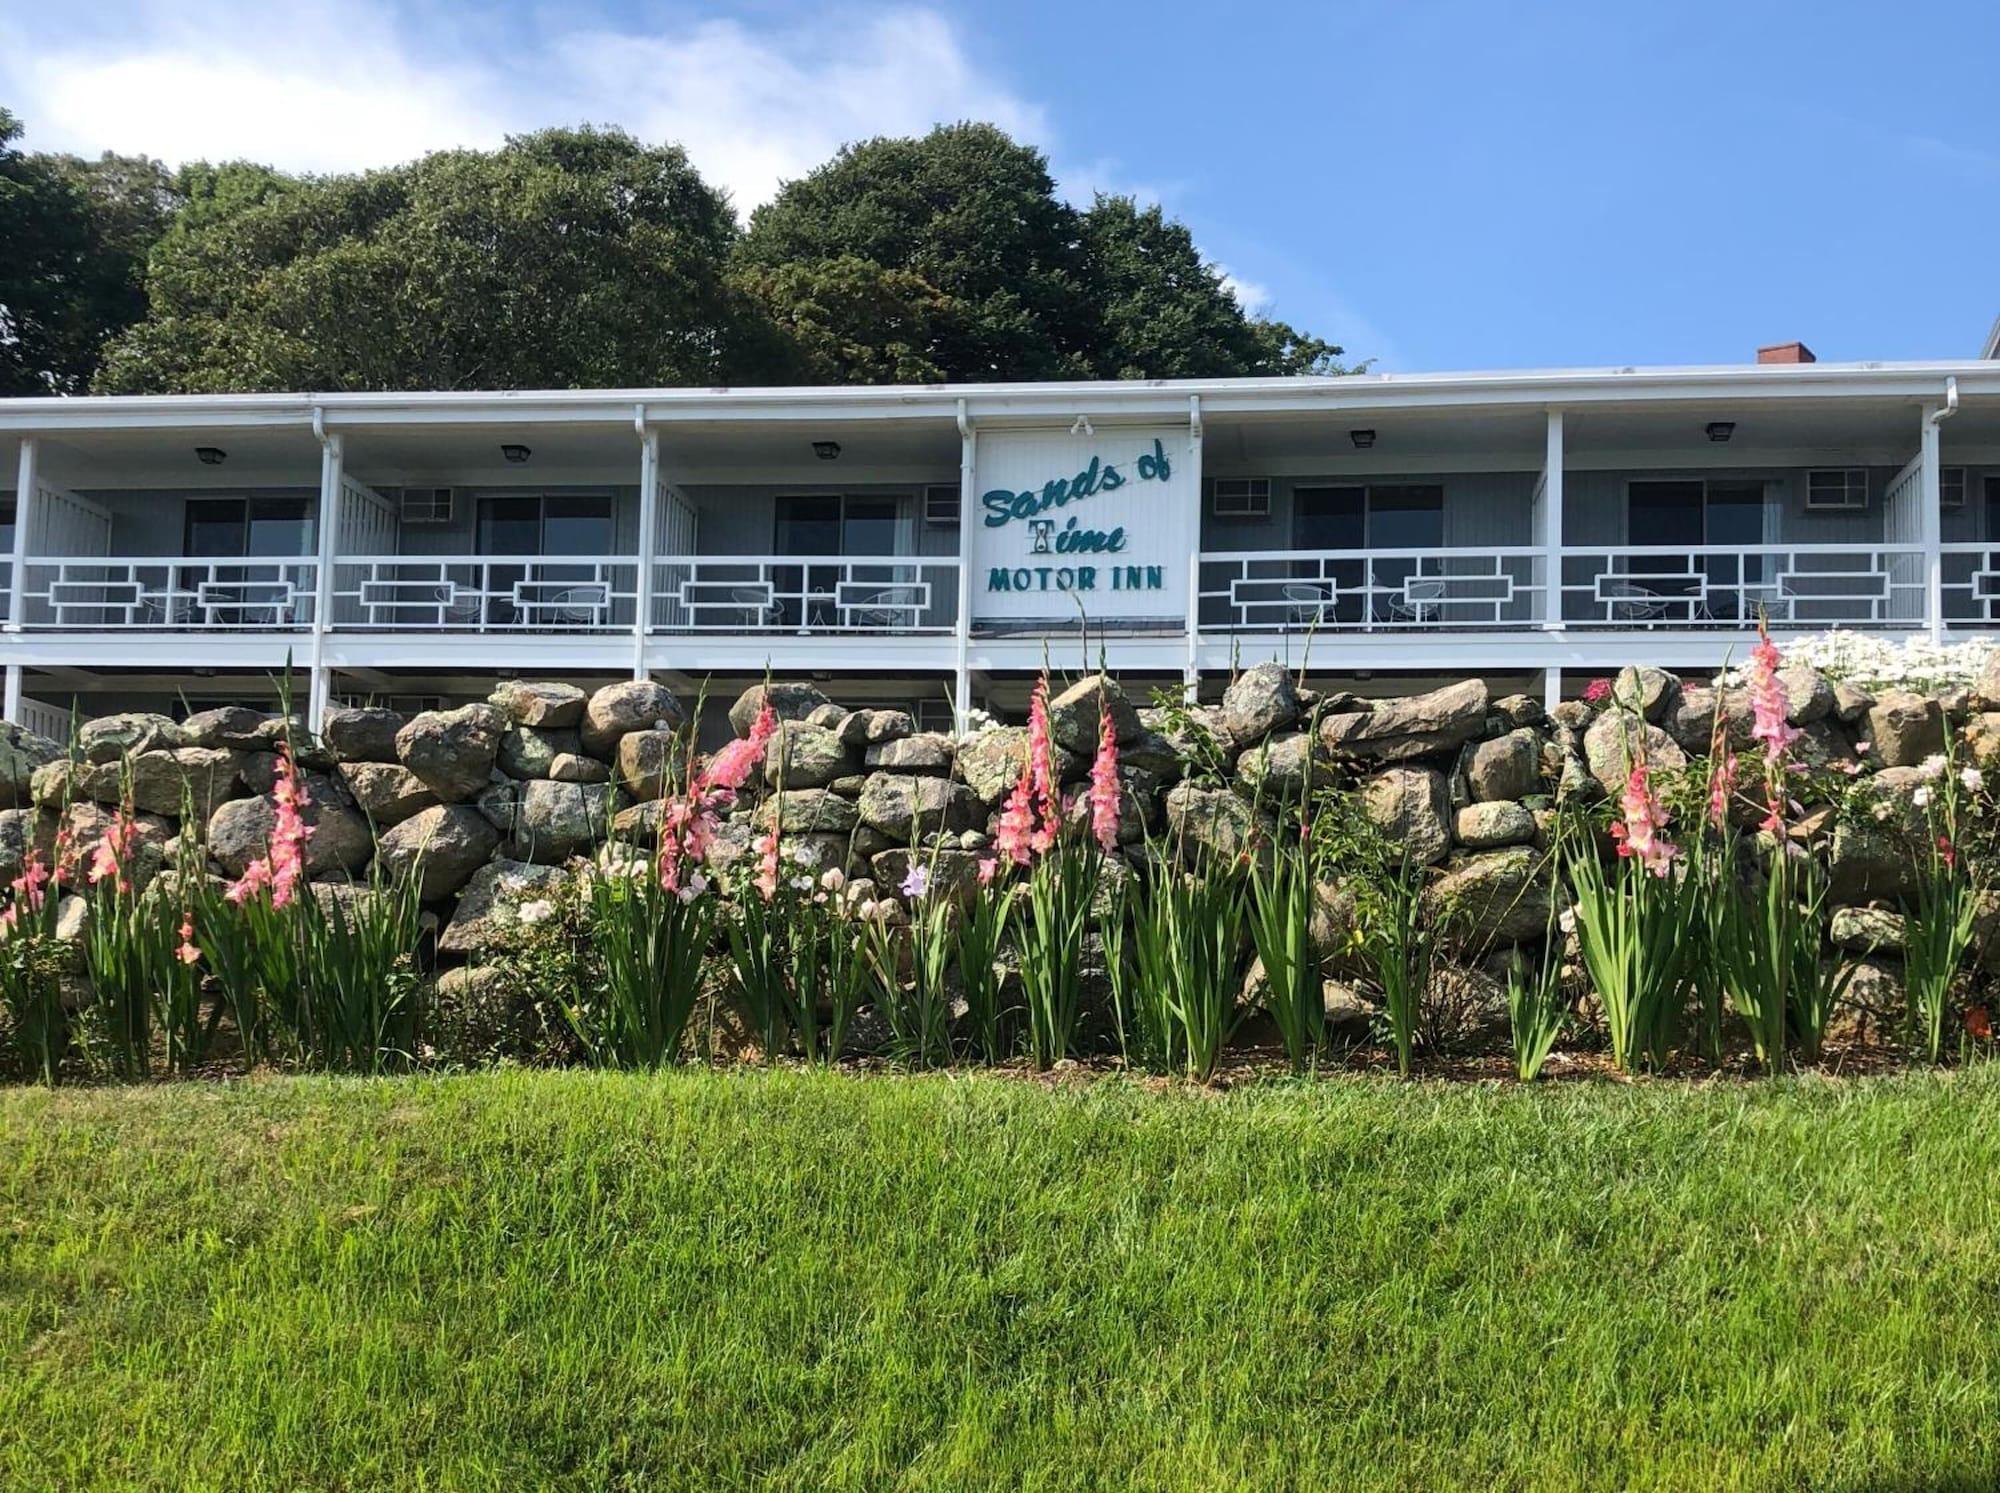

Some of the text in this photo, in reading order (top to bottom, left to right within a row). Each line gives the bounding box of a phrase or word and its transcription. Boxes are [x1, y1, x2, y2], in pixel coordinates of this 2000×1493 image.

[982, 438, 1171, 527] Sands of
[1028, 516, 1126, 555] Time
[988, 565, 1162, 592] MOTOR INN
